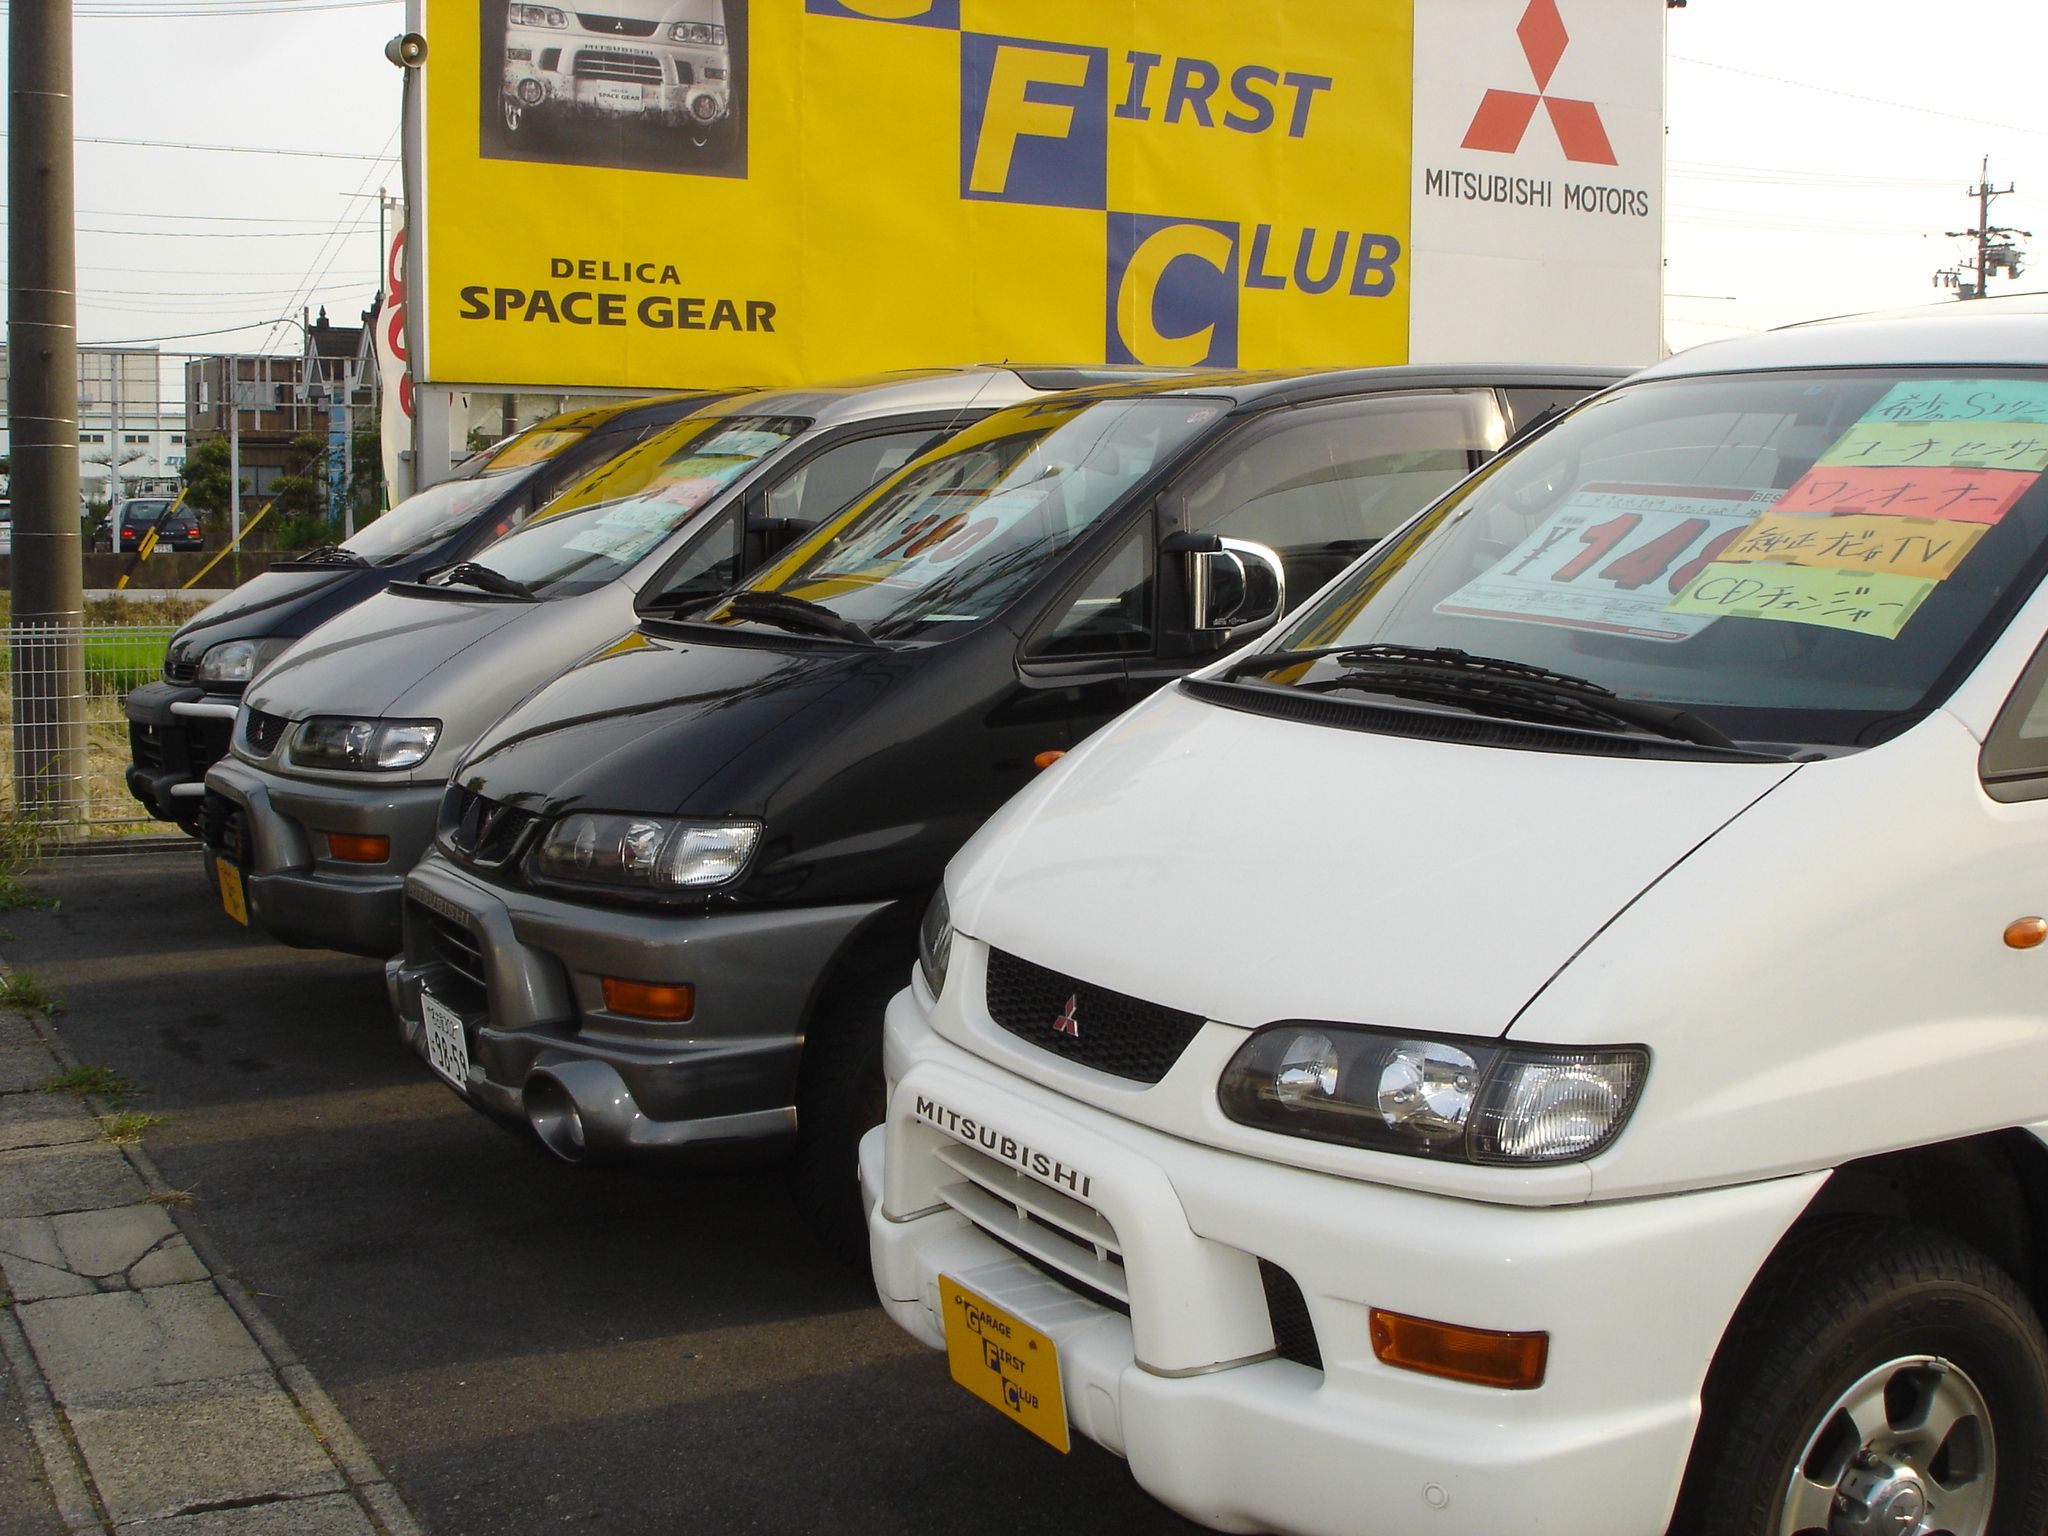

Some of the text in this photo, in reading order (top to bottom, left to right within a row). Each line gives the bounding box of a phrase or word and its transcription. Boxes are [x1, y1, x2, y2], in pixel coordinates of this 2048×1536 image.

[969, 45, 1332, 193] FIRST
[1425, 168, 1648, 216] MITSUBISHI MOTORS
[551, 257, 681, 285] DELICA
[460, 285, 776, 332] SPACE GEAR
[1117, 223, 1401, 367] CLUB
[1809, 481, 1999, 513] ワンオーナー
[1694, 577, 1904, 623] CDチェンジャー
[916, 1095, 1091, 1198] MITSUBISHI
[965, 1302, 1012, 1339] GARAGE
[984, 1339, 1026, 1374] FIRST
[1003, 1377, 1040, 1412] CLUB
